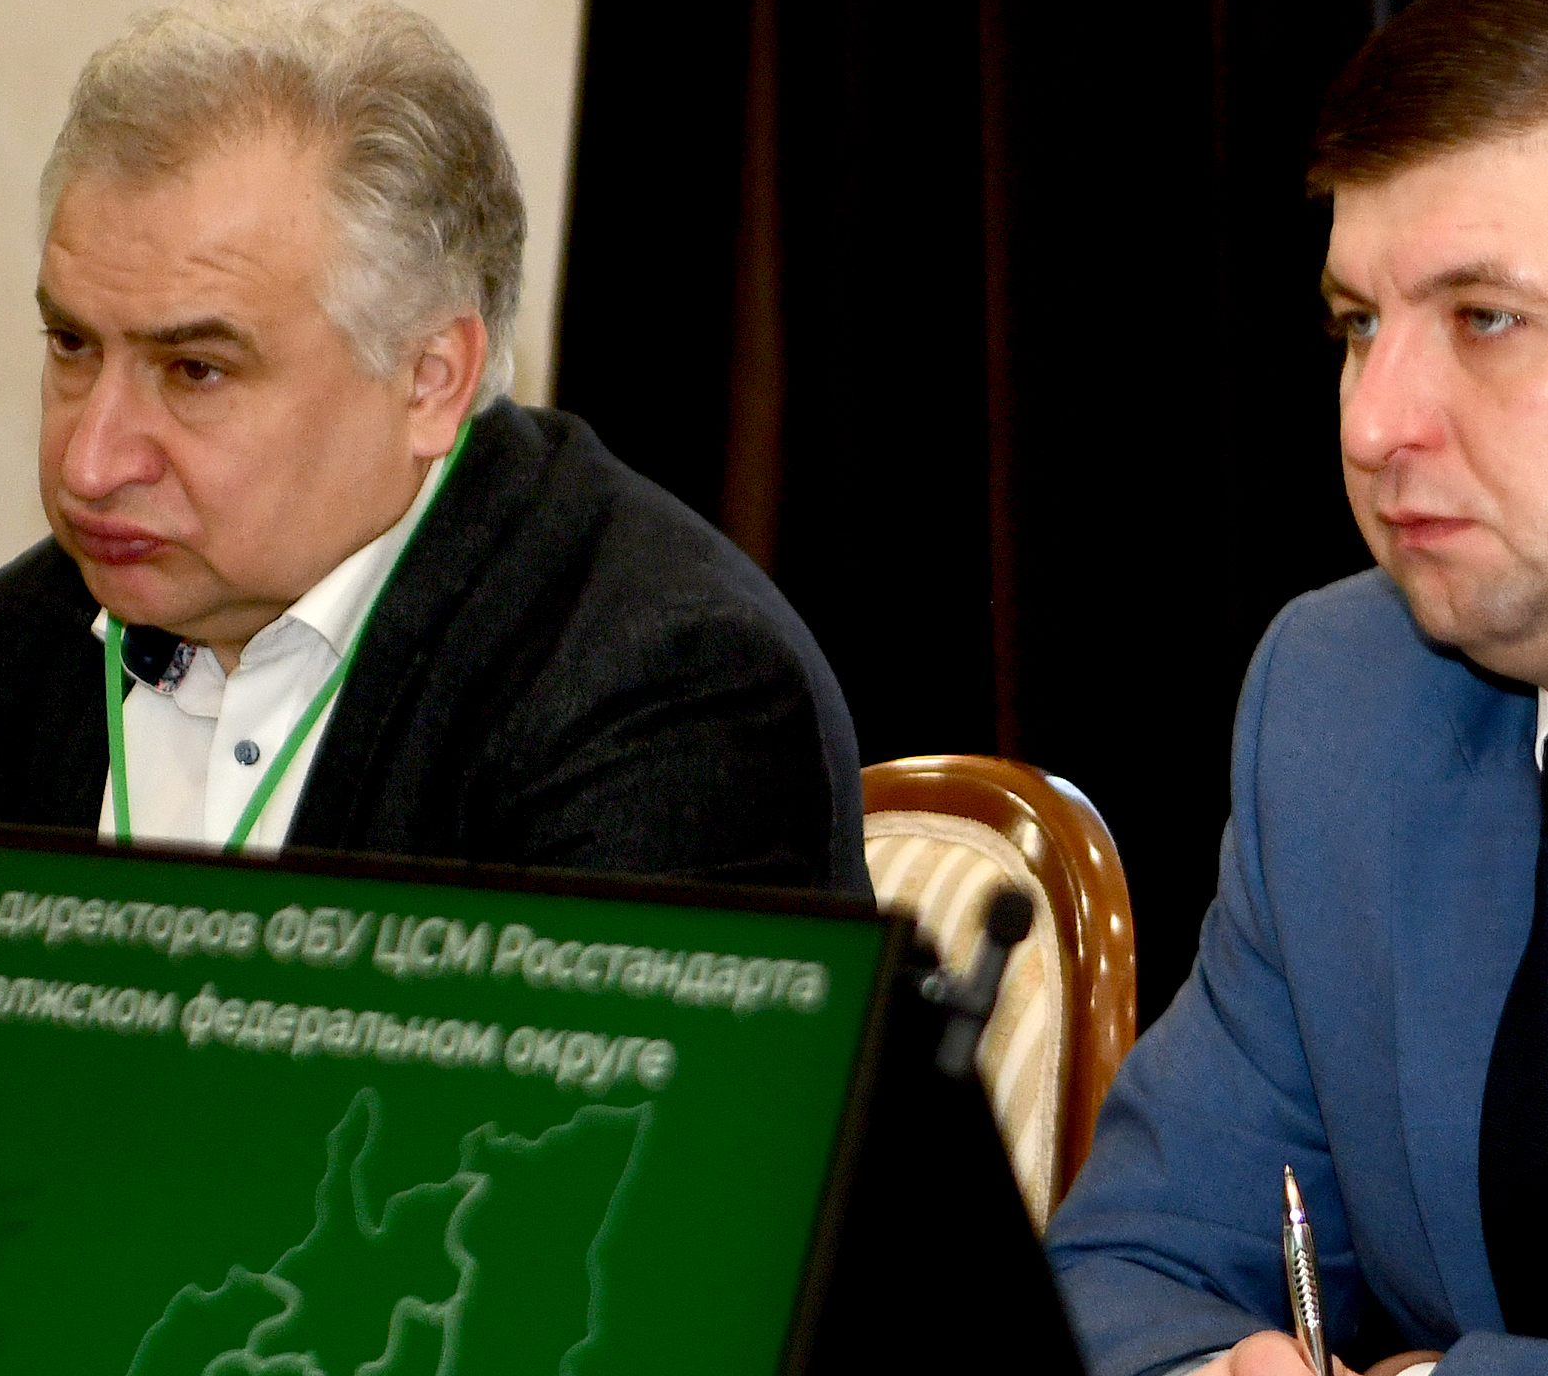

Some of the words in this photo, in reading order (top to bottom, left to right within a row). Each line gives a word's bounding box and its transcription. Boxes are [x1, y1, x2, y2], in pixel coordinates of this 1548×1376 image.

[263, 903, 376, 969] ФБУ
[373, 912, 494, 979] ЦСМ
[492, 923, 829, 1017] Росстандарта
[181, 980, 505, 1069] федеральном
[504, 1024, 676, 1096] округе
